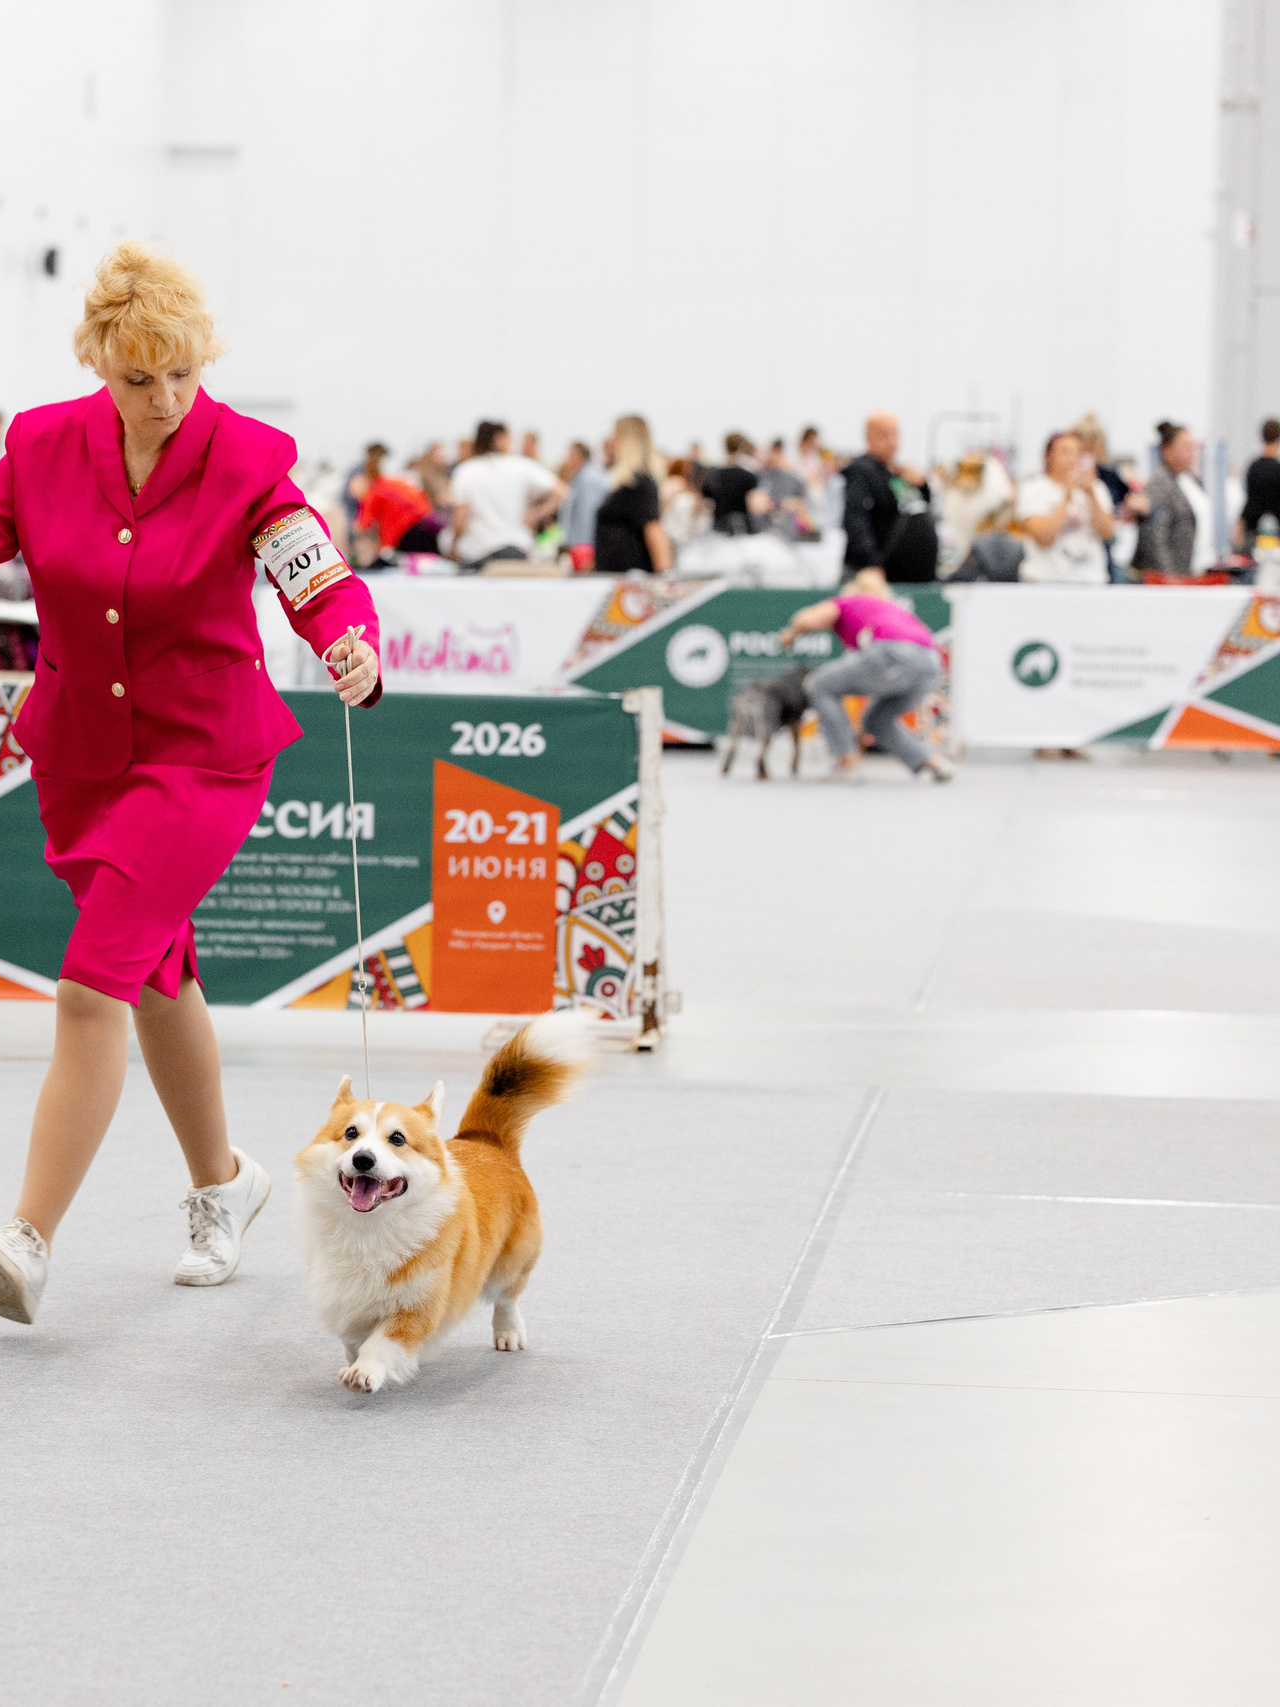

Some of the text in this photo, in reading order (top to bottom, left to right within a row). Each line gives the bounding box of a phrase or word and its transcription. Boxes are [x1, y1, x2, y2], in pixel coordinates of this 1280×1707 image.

[286, 543, 322, 581] 207
[312, 565, 344, 586] 21.06.2026
[450, 722, 546, 757] 2026
[248, 800, 375, 840] ССИЯ
[443, 809, 548, 845] 20-21
[447, 855, 547, 880] ИЮНЯ
